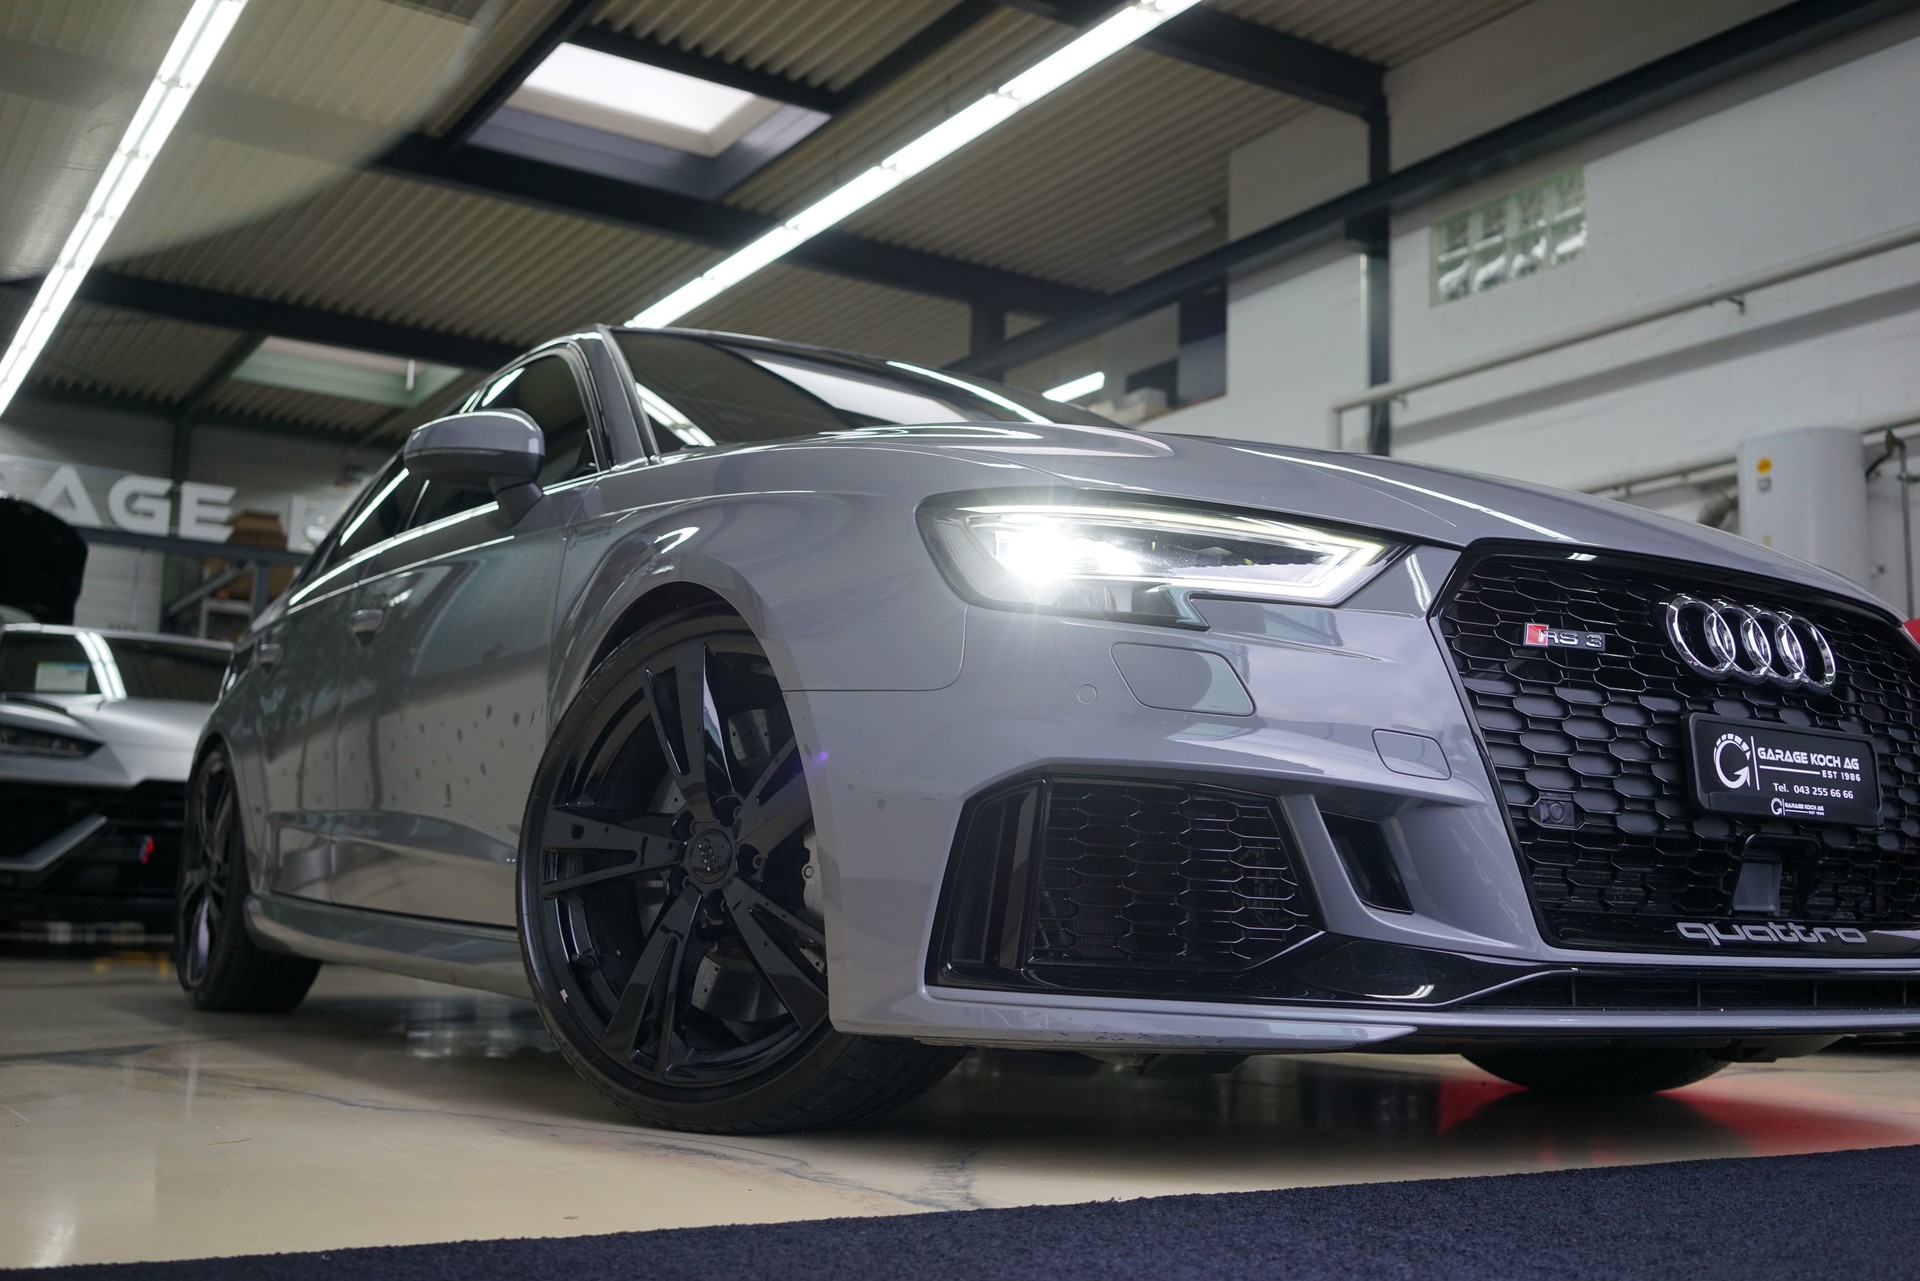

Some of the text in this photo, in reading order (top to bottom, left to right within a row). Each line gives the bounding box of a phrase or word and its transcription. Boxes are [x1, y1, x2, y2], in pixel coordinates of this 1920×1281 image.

[0, 460, 236, 542] AGE
[1537, 629, 1602, 648] RS 3
[1757, 747, 1860, 770] GARAGE KOCH AG
[1821, 769, 1861, 782] EST 1986
[1772, 782, 1854, 800] Tel. 043 255 66 66
[1676, 921, 1868, 946] quattro
